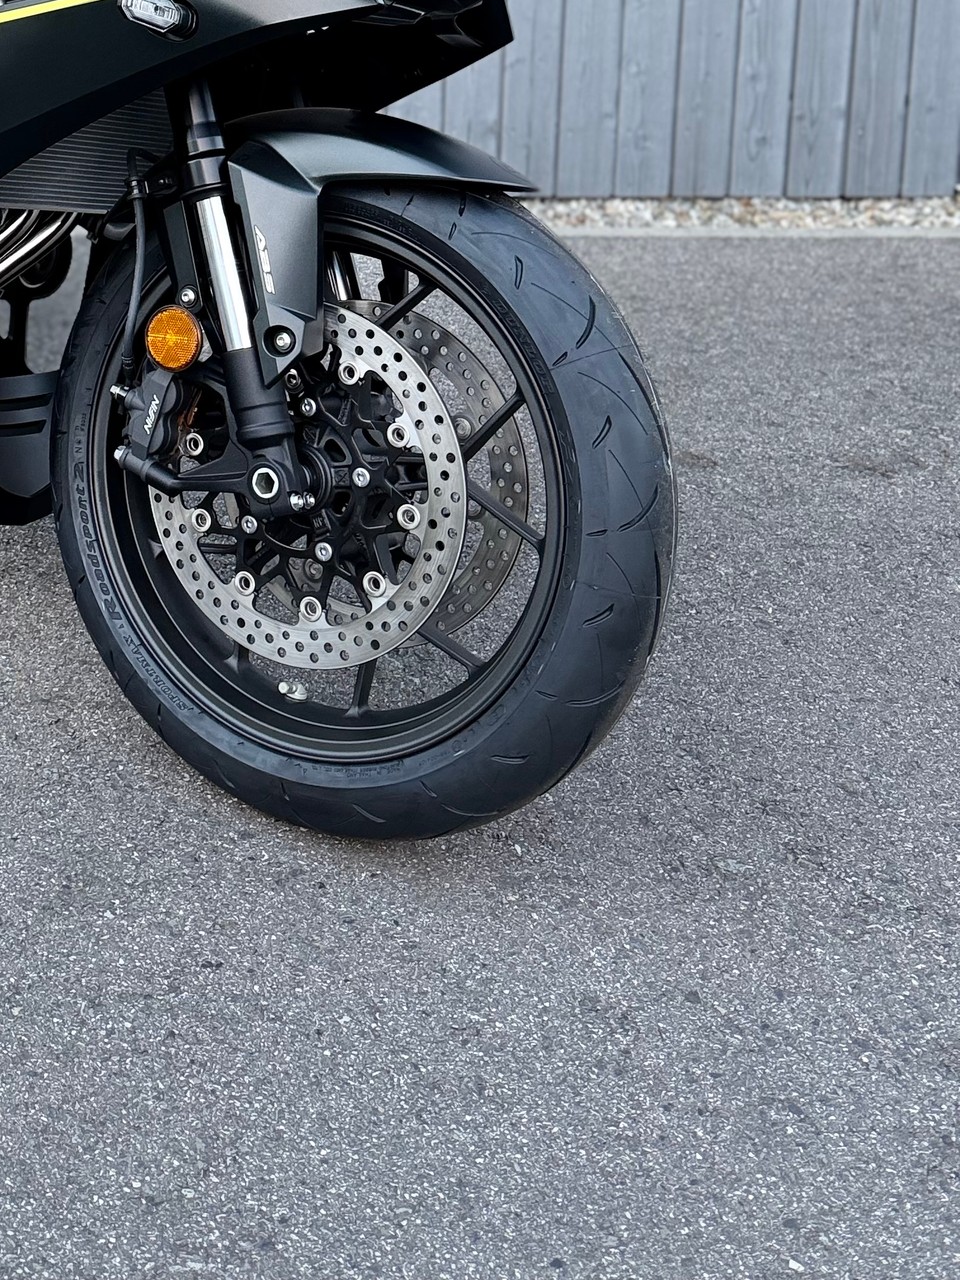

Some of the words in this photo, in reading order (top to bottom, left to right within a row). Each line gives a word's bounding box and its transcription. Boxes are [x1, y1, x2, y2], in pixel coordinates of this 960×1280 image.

[254, 224, 276, 295] ABS
[143, 394, 160, 435] NISSIN
[76, 484, 123, 621] Roadsport
[123, 634, 189, 711] SPORTMAX
